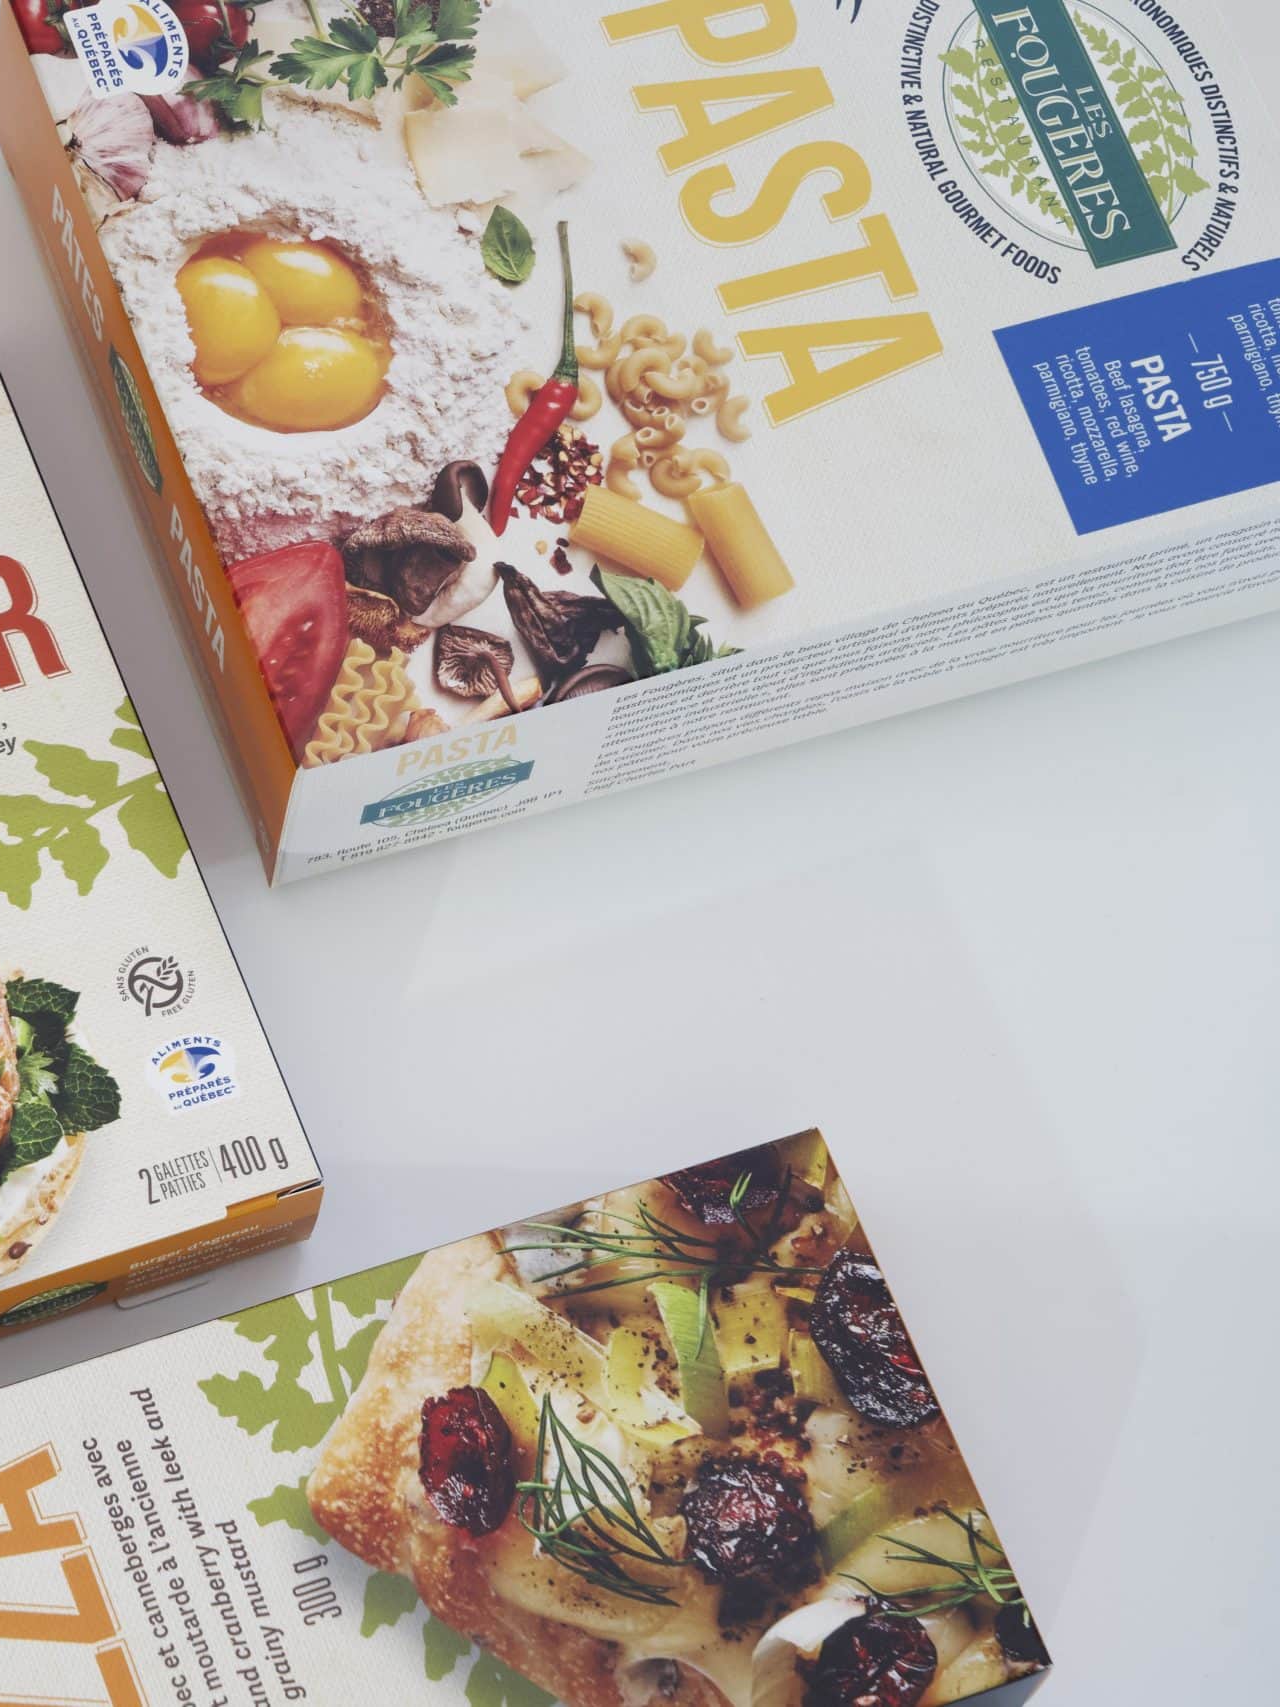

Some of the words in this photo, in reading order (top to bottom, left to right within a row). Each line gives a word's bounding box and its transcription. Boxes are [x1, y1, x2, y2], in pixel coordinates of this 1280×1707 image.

[86, 12, 124, 88] PRÉPARÉS
[901, 0, 940, 89] DISTINCTIVE
[902, 95, 923, 106] &
[991, 8, 1131, 240] FOUGÈRES
[1076, 85, 1113, 138] LES
[905, 109, 948, 181] NATURAL
[1200, 84, 1240, 180] DISTINCTIFS
[599, 0, 943, 428] PASTA
[937, 180, 1008, 250] GOURMET
[1218, 182, 1239, 194] &
[1181, 196, 1237, 272] NATURELS
[51, 183, 105, 344] PÂTES
[1000, 242, 1062, 284] FOODS
[1226, 313, 1273, 392] parmigiano,
[1248, 303, 1277, 352] ricotta,
[1130, 354, 1192, 442] PASTA
[1191, 353, 1233, 392] 750
[1032, 361, 1077, 441] parmigiano,
[1071, 441, 1098, 486] thyme
[1055, 354, 1084, 403] ricotta,
[1077, 405, 1119, 482] mozzarella,
[1075, 346, 1111, 413] tomatoes,
[1104, 414, 1128, 439] red
[1116, 440, 1139, 478] wine,
[1103, 359, 1131, 393] Beef
[1119, 393, 1151, 453] lasagna,
[1203, 394, 1233, 409] g
[169, 503, 226, 673] PASTA
[395, 720, 518, 777] PASTA
[118, 945, 150, 974] GLUTEN
[116, 976, 131, 1002] SANS
[161, 1003, 184, 1017] FREE
[151, 1036, 222, 1065] ALIMENTS
[168, 1076, 232, 1101] PRÉPARÉS
[138, 1167, 161, 1205] 2
[153, 1150, 210, 1182] GALETTES
[220, 1135, 267, 1180] 400
[268, 1136, 289, 1170] g
[159, 1171, 207, 1201] PATTIES
[129, 1386, 165, 1432] and
[82, 1437, 113, 1488] avec
[151, 1435, 186, 1484] leek
[171, 1486, 206, 1539] with
[103, 1492, 169, 1639] canneberges
[156, 1554, 179, 1573] à
[214, 1518, 271, 1618] mustard
[292, 1553, 329, 1574] g
[195, 1544, 252, 1660] cranberry
[292, 1576, 342, 1626] 300
[158, 1643, 180, 1668] et
[168, 1576, 225, 1693] moutarde
[260, 1623, 308, 1701] grainy
